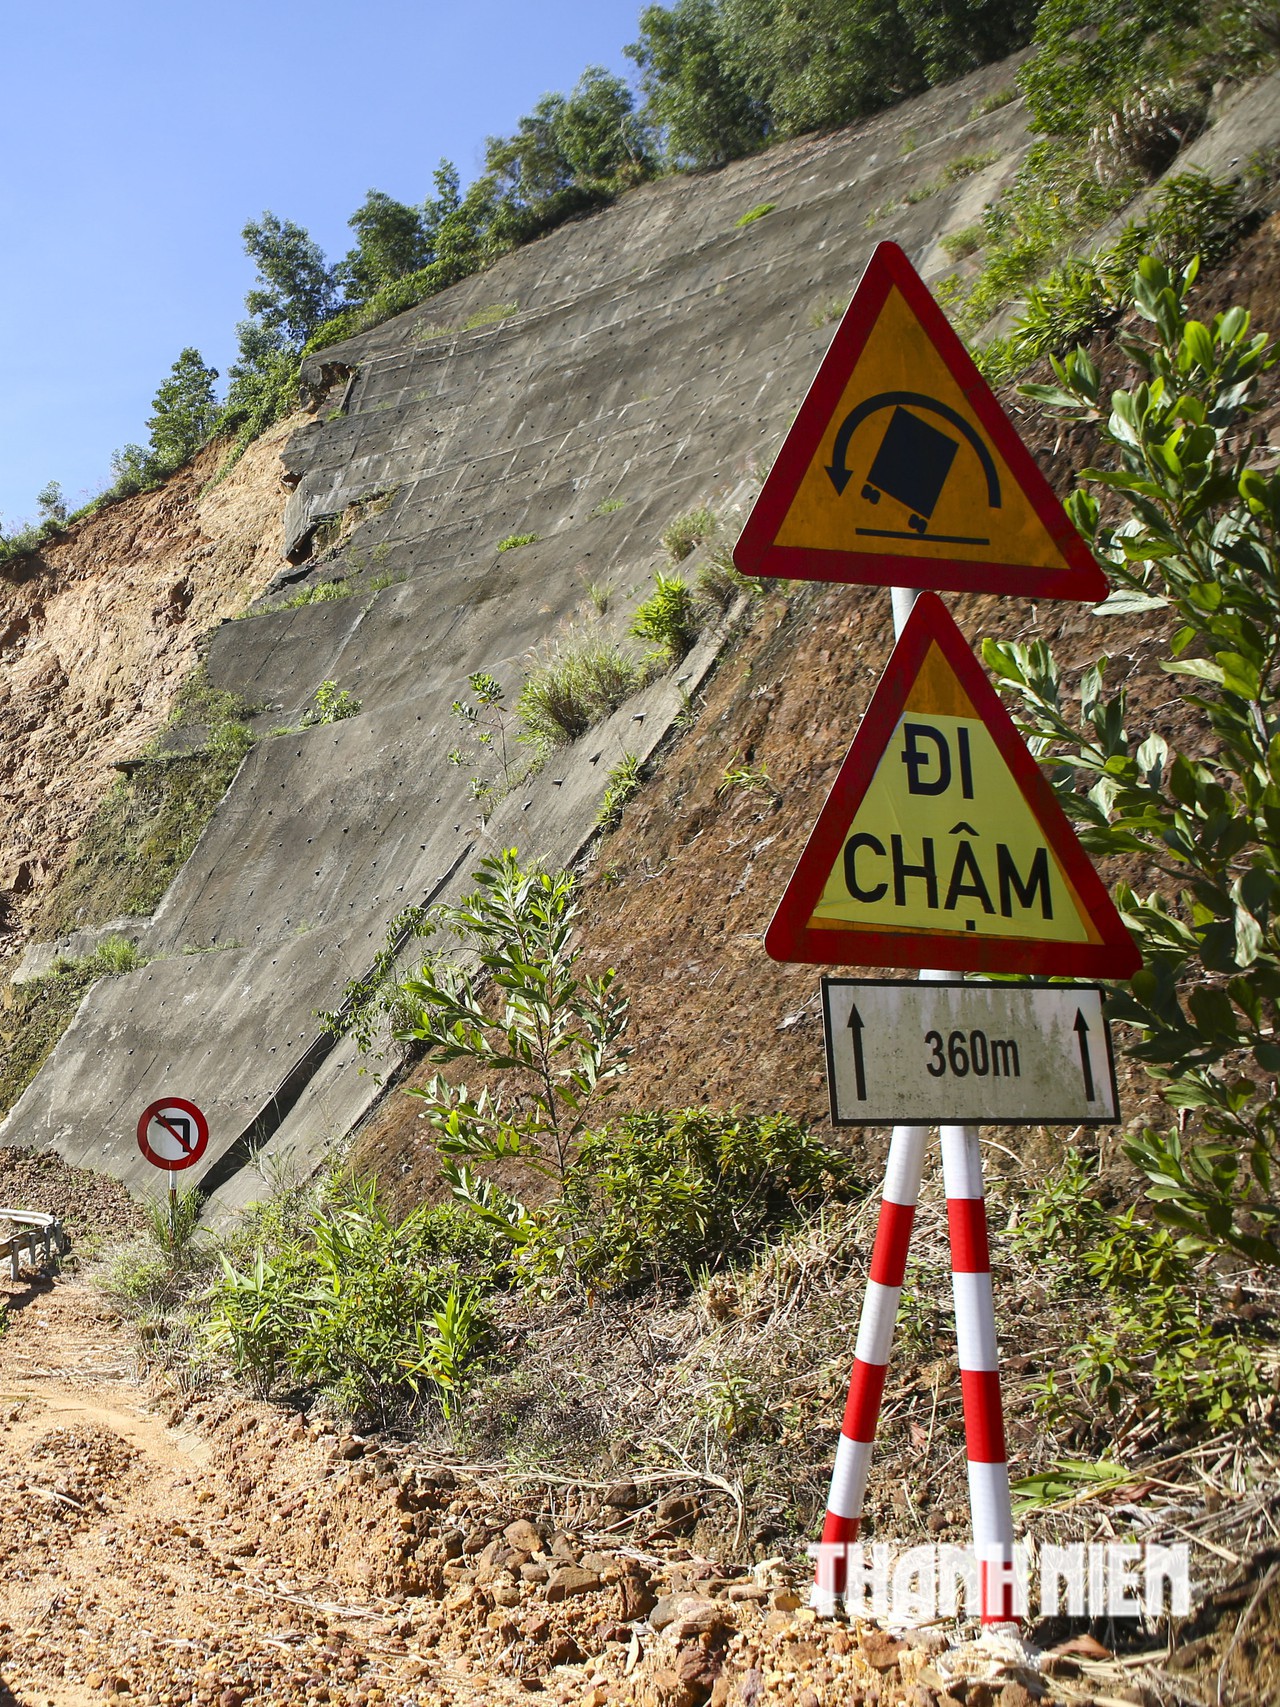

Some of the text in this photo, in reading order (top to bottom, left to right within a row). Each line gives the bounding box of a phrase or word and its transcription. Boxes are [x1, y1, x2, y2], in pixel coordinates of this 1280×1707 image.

[901, 723, 974, 799] ĐI
[843, 822, 1053, 931] CHẬM
[924, 1030, 1020, 1078] 360m
